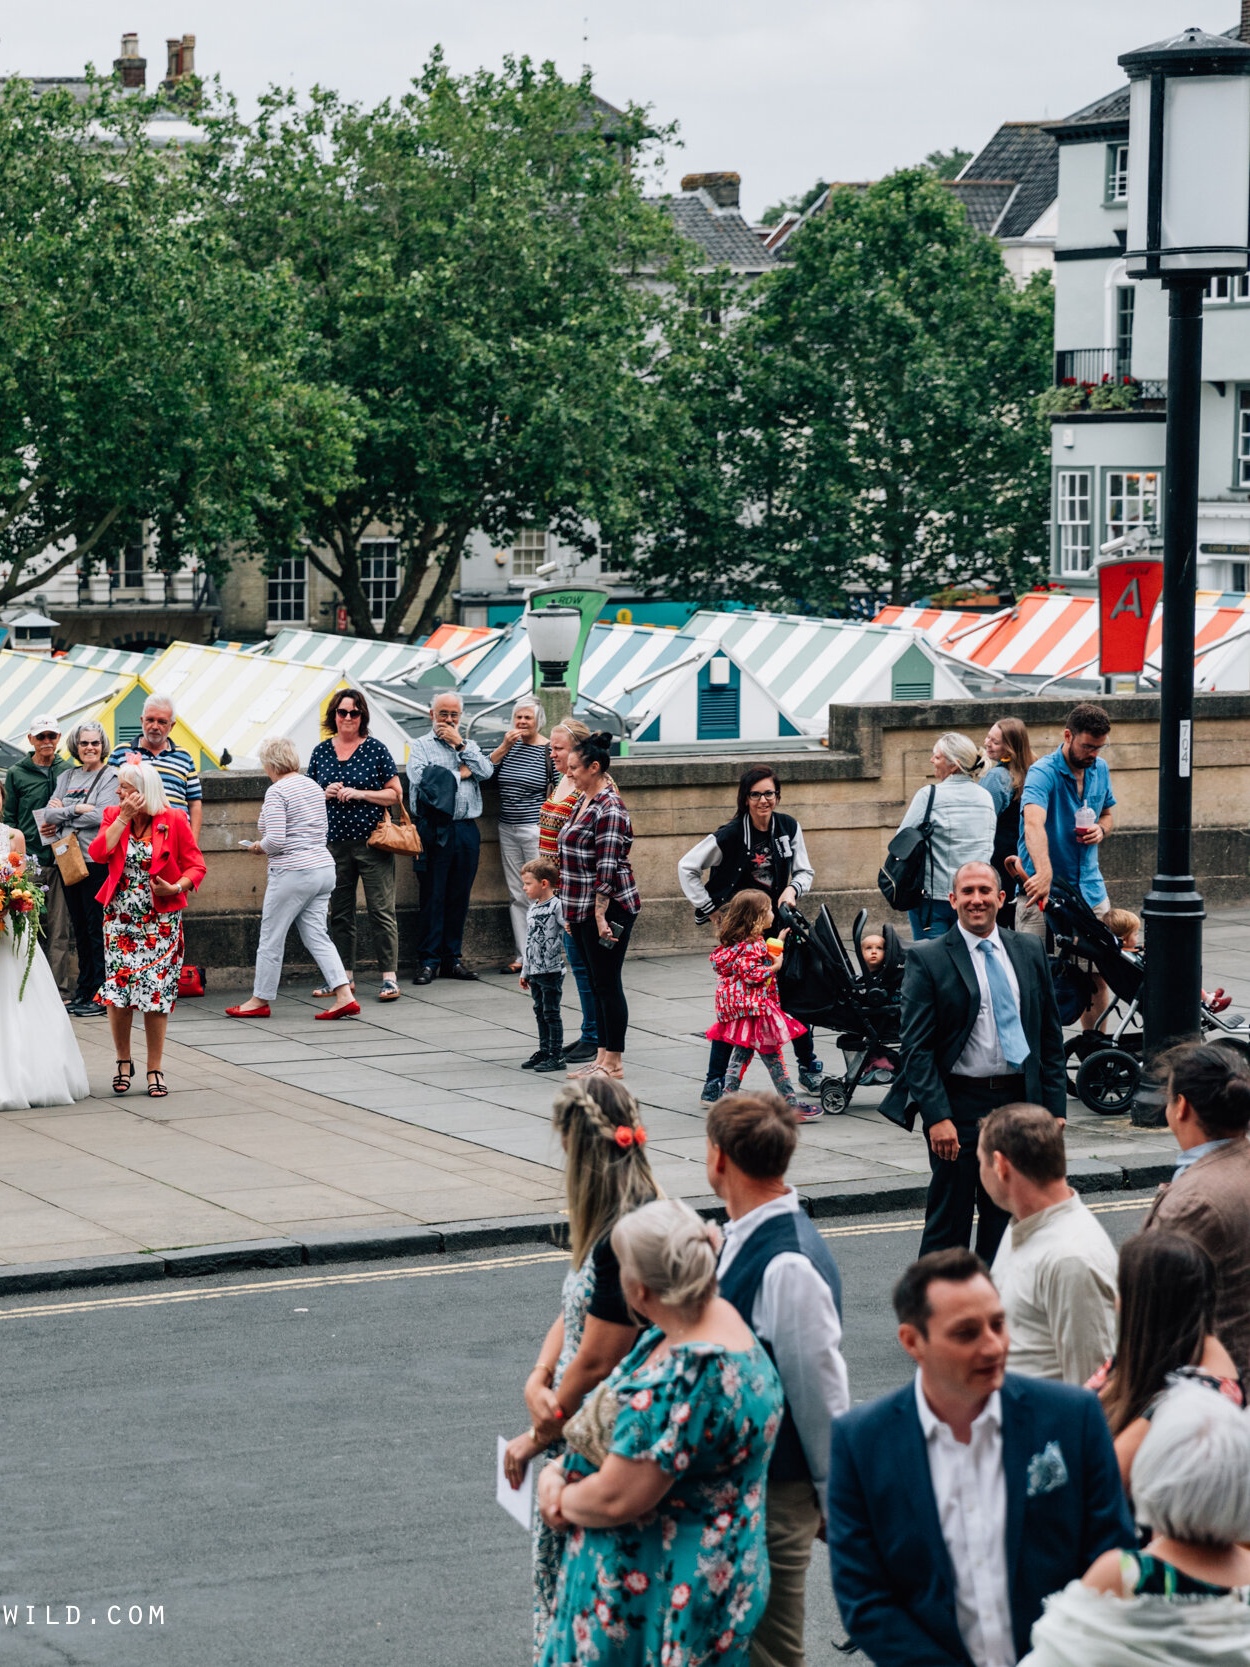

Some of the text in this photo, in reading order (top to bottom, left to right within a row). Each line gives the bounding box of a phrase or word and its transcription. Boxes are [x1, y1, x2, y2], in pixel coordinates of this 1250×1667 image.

[559, 596, 584, 604] ROW
[1110, 578, 1143, 619] A
[1181, 724, 1189, 763] 704
